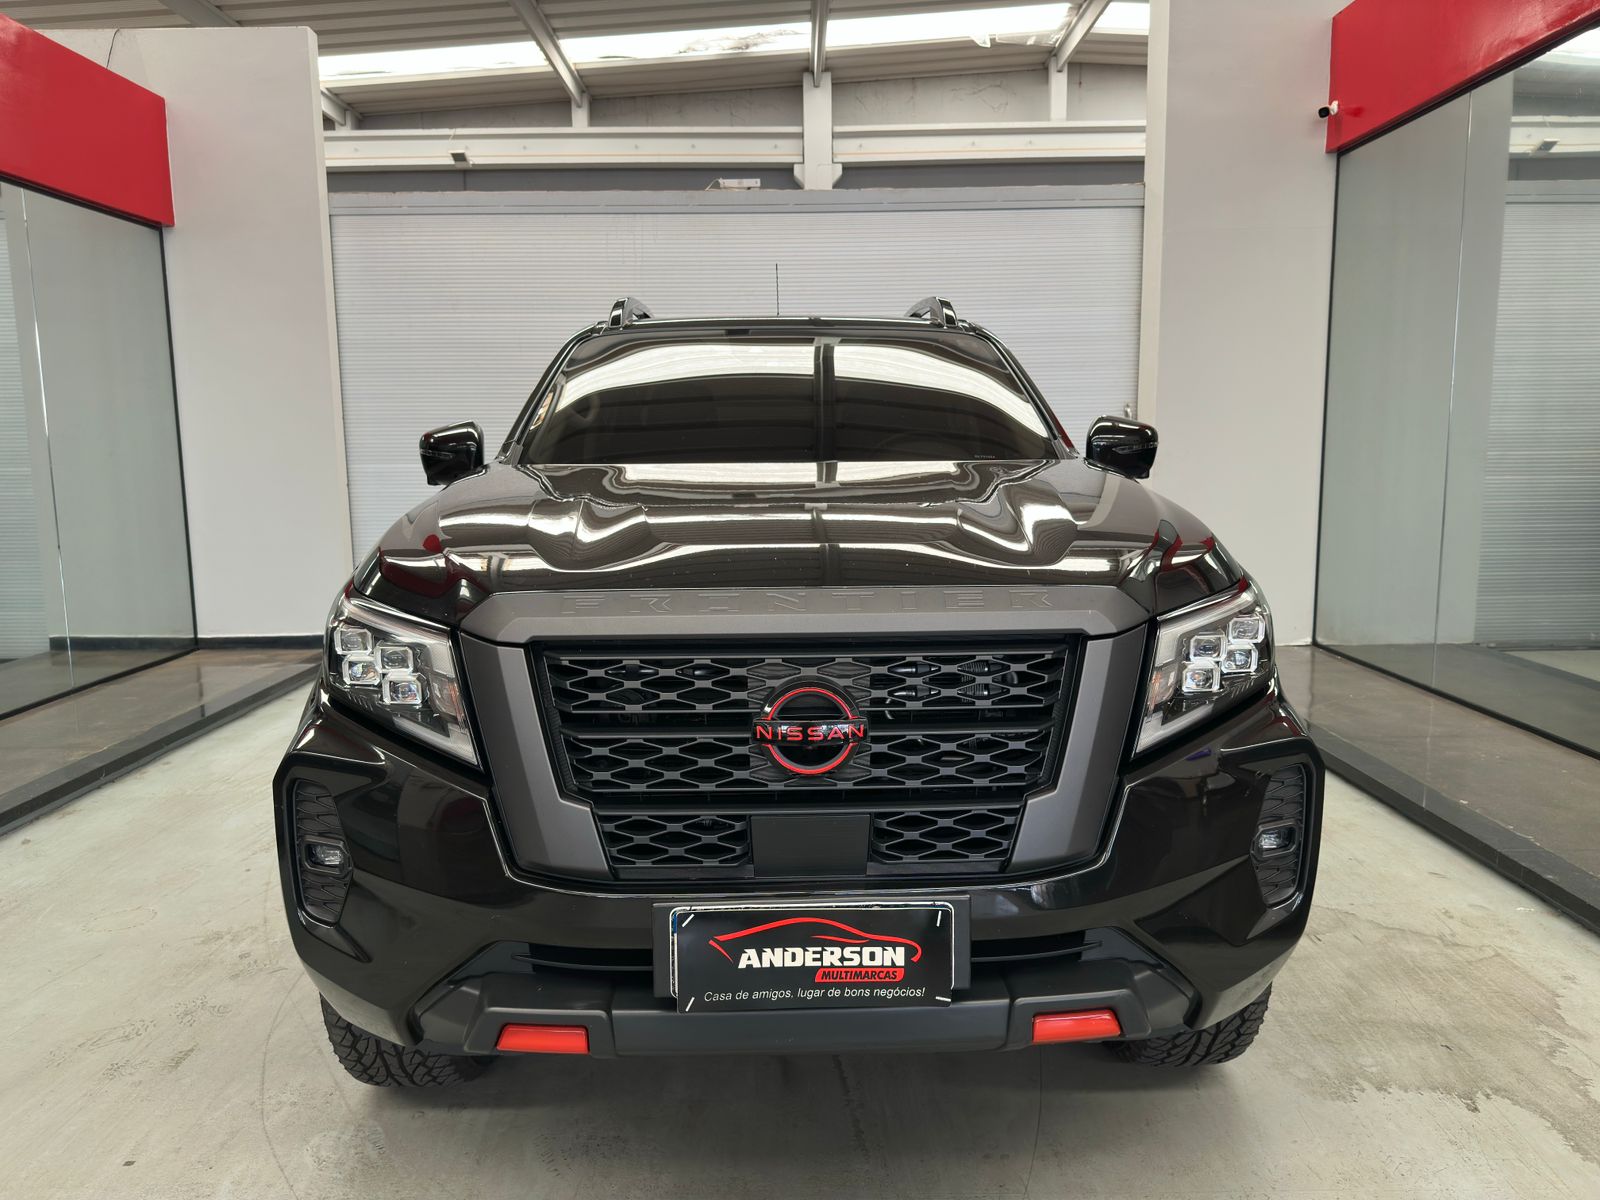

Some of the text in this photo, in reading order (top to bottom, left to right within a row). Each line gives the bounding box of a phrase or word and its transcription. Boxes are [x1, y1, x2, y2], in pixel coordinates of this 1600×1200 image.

[755, 724, 865, 741] NISSAN
[737, 946, 905, 969] ANDERSON
[820, 970, 898, 981] MULTIMARCAS
[704, 991, 732, 1002] Casa
[735, 990, 749, 1000] de
[797, 987, 825, 999] lugar
[827, 987, 841, 997] de
[844, 986, 870, 997] bons
[873, 986, 926, 999] negócios!
